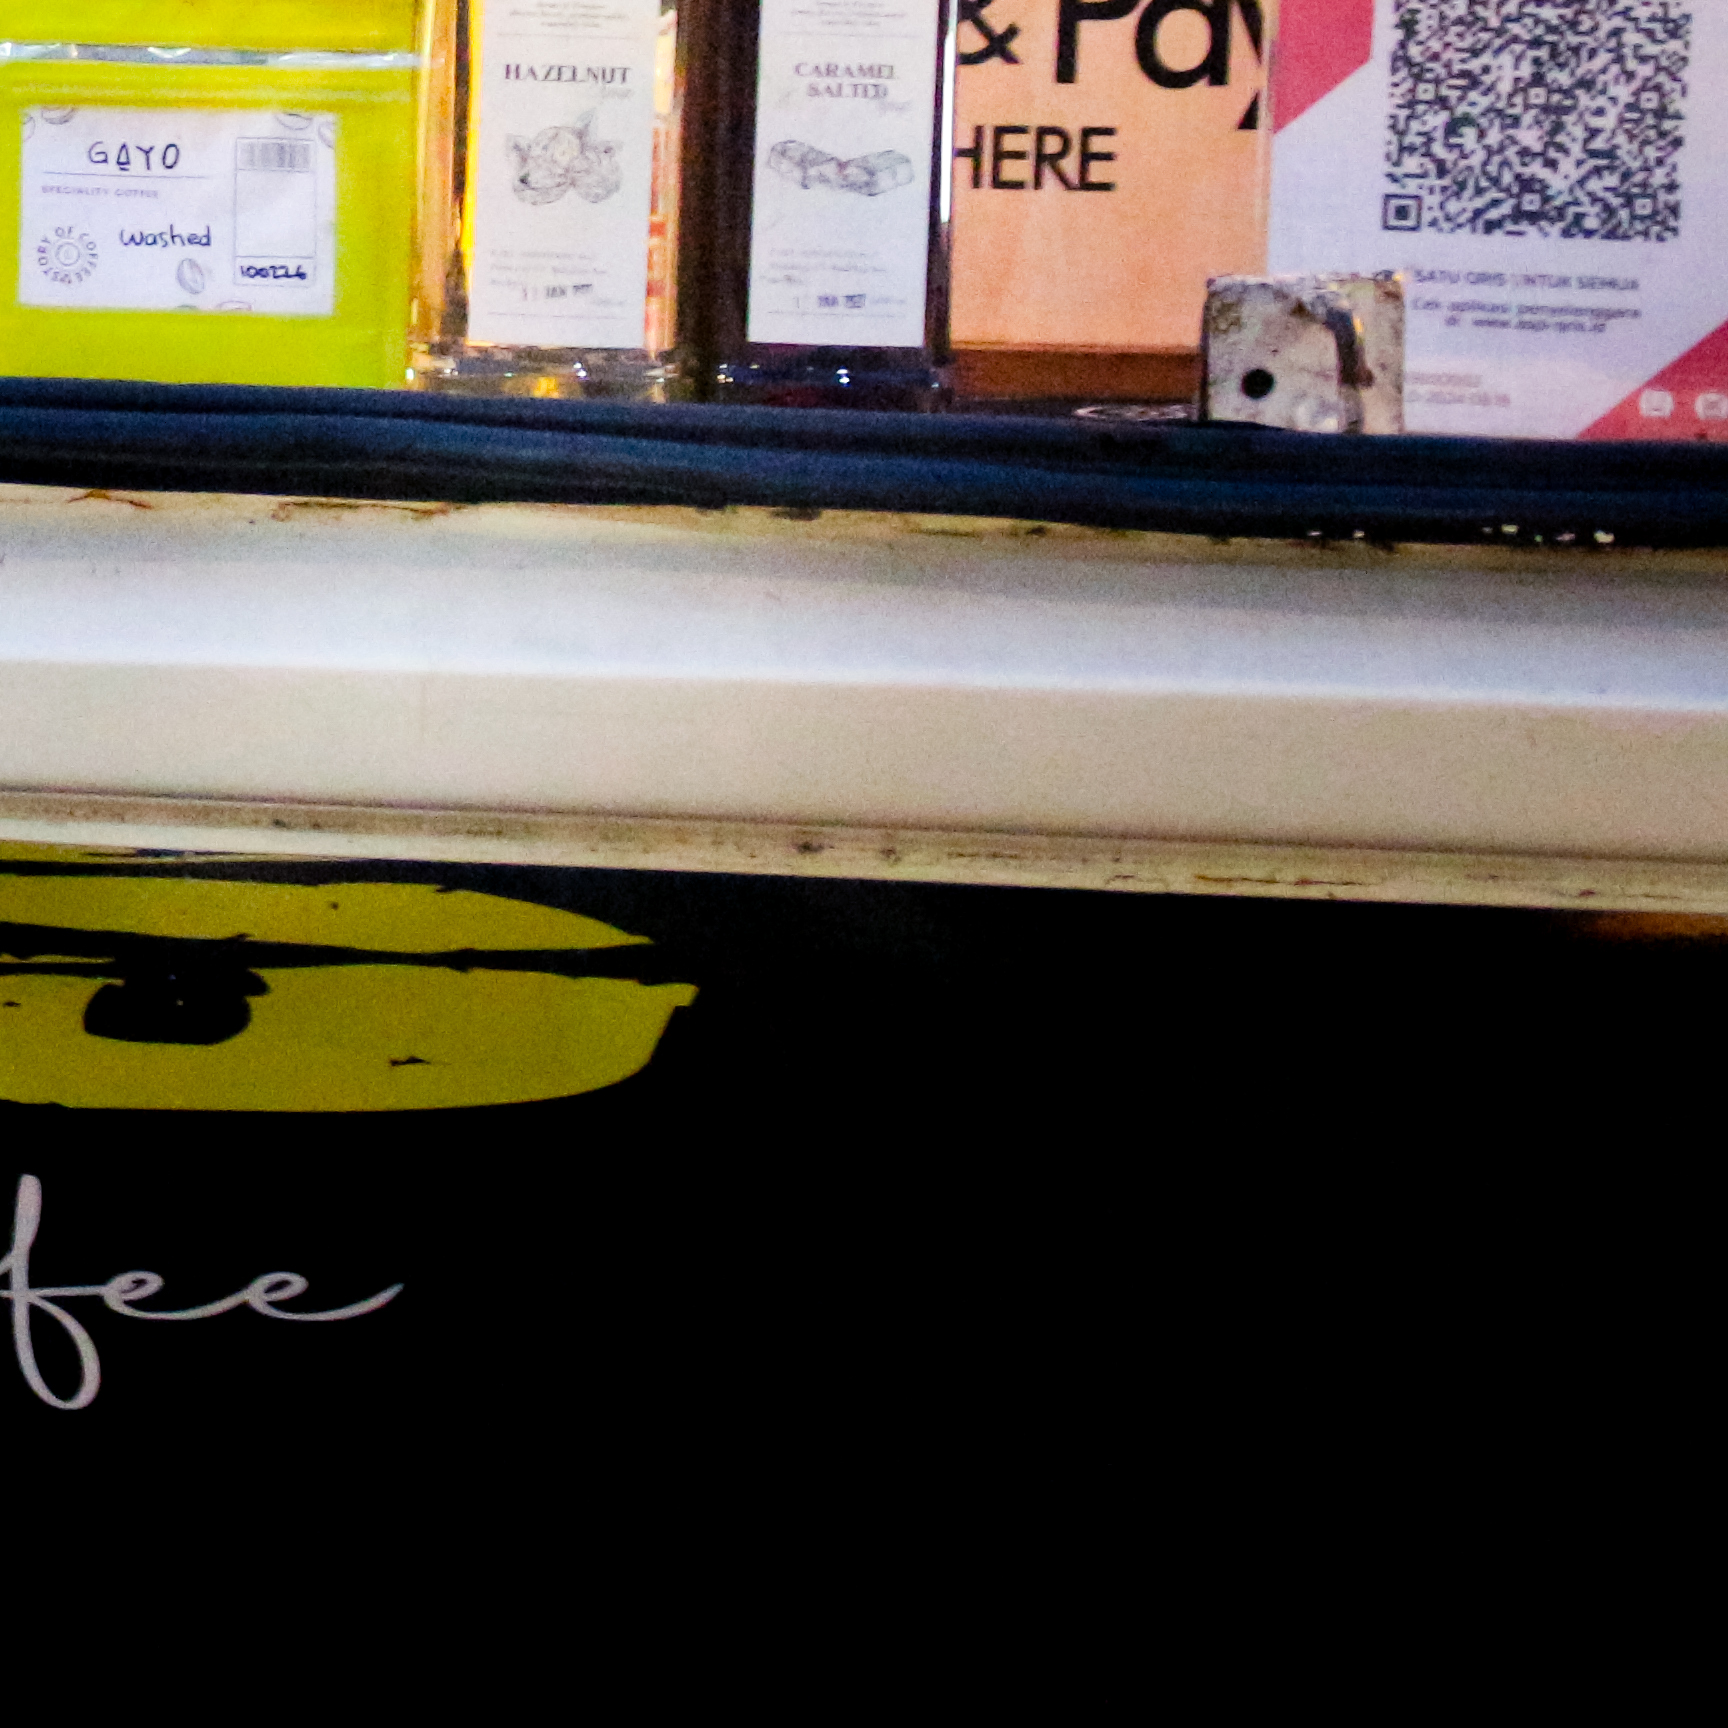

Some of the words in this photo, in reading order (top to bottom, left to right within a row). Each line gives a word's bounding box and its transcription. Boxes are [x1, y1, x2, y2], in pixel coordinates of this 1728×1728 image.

[504, 63, 633, 85] HAZELNUT
[794, 62, 895, 79] CARAMEL
[806, 82, 889, 99] SALTED
[87, 140, 181, 172] GAYO
